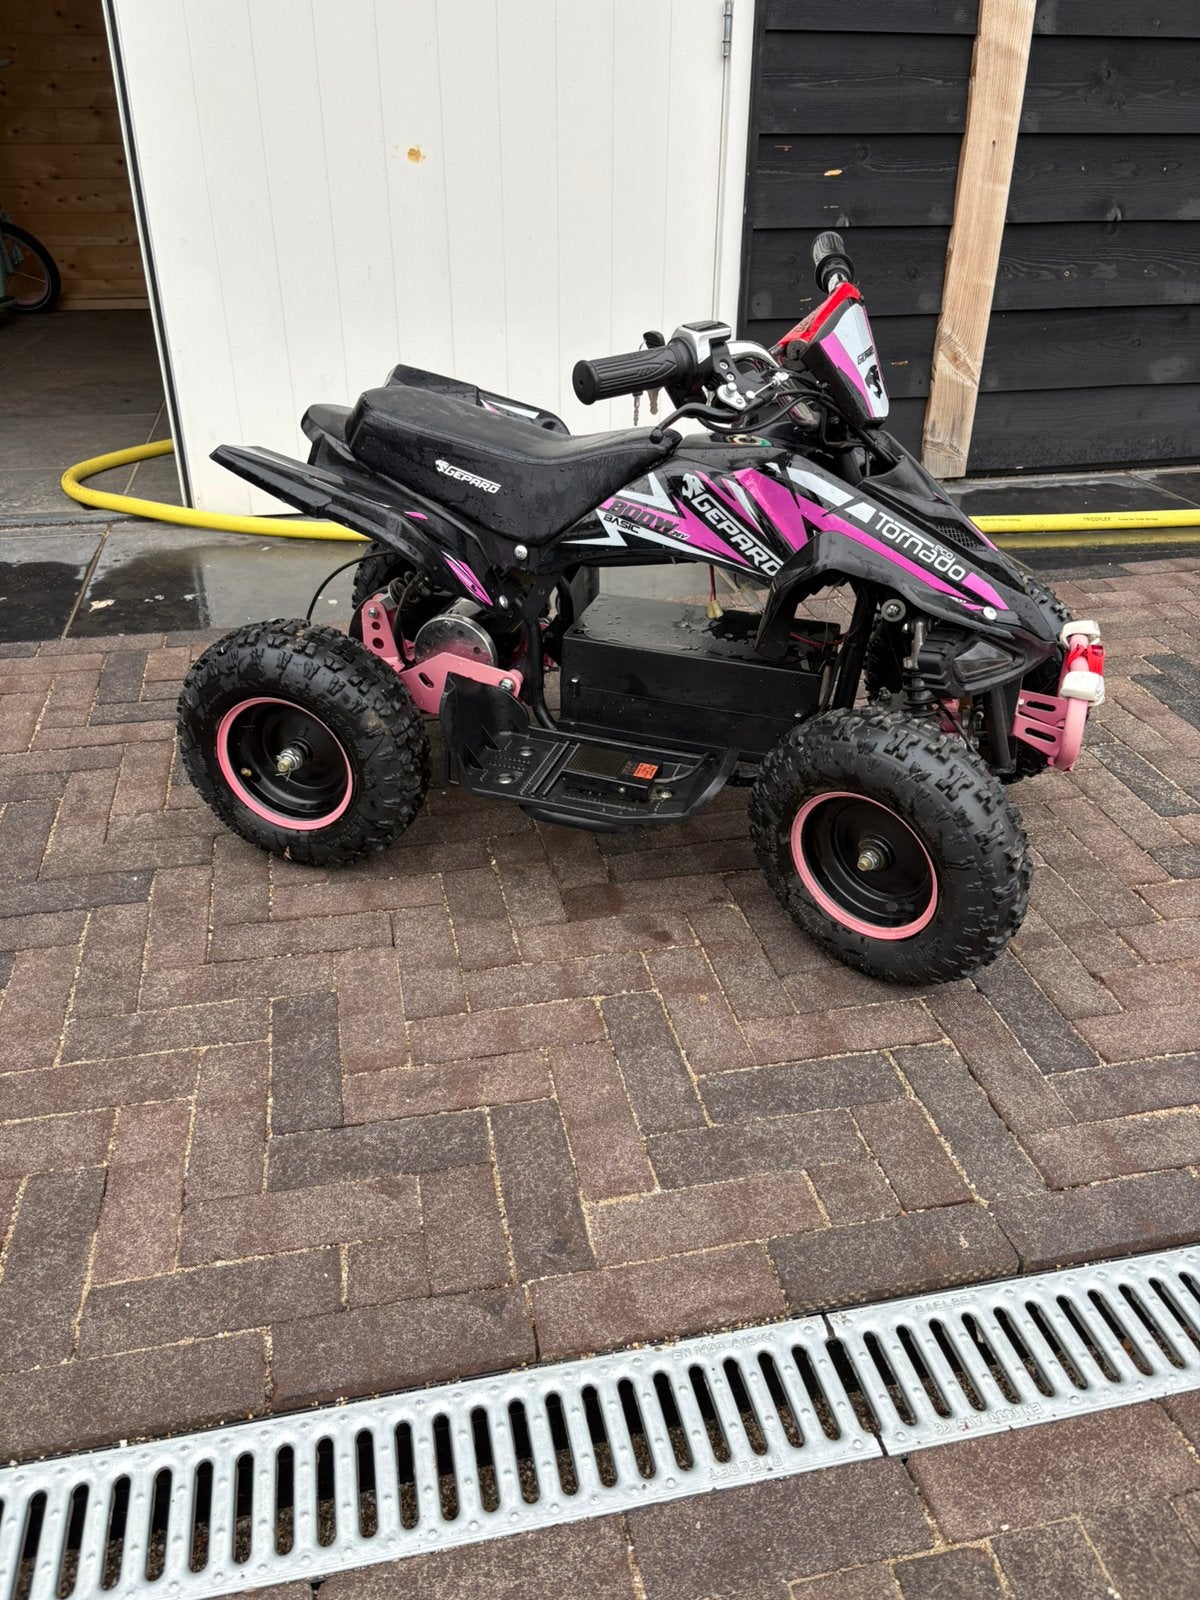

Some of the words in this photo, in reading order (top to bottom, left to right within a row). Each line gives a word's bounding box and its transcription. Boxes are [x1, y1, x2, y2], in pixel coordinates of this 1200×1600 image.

[446, 465, 502, 494] GEPARD
[603, 513, 640, 534] BASIC
[608, 500, 680, 535] 800W
[671, 530, 688, 539] 36V
[694, 493, 785, 577] GEPARD
[874, 511, 967, 583] Tornado
[672, 1346, 692, 1360] EN
[693, 1341, 726, 1356] 1433
[731, 1334, 757, 1350] A15
[989, 1407, 1020, 1423] 1433
[1022, 1402, 1043, 1416] EN
[956, 1414, 982, 1432] A15
[709, 1455, 784, 1481] BIELBET
